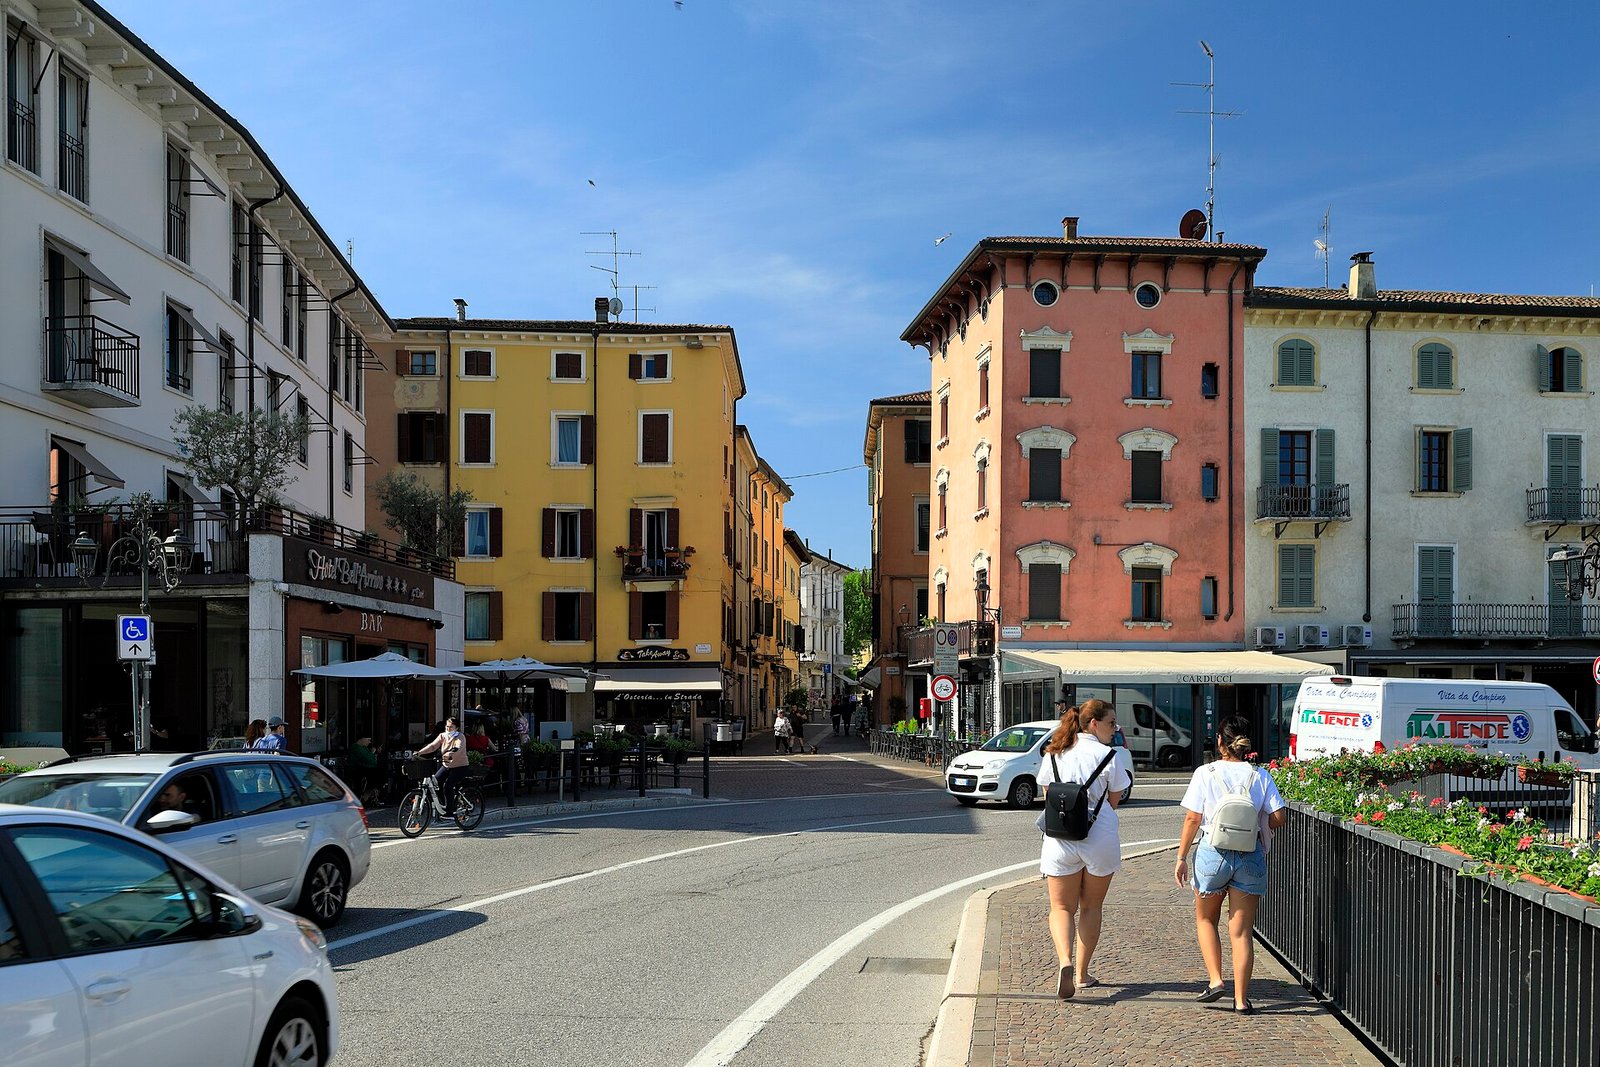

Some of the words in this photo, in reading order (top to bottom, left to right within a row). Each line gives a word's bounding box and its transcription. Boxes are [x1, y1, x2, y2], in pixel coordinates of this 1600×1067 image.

[308, 549, 338, 580] Hotel
[360, 612, 383, 632] BAR
[1182, 675, 1232, 683] CARDUCCI
[1306, 686, 1322, 696] Vita
[1326, 688, 1336, 697] da
[1340, 688, 1377, 701] Camping
[1438, 690, 1456, 700] Vita
[1458, 692, 1469, 700] da
[1472, 690, 1507, 703] Camping
